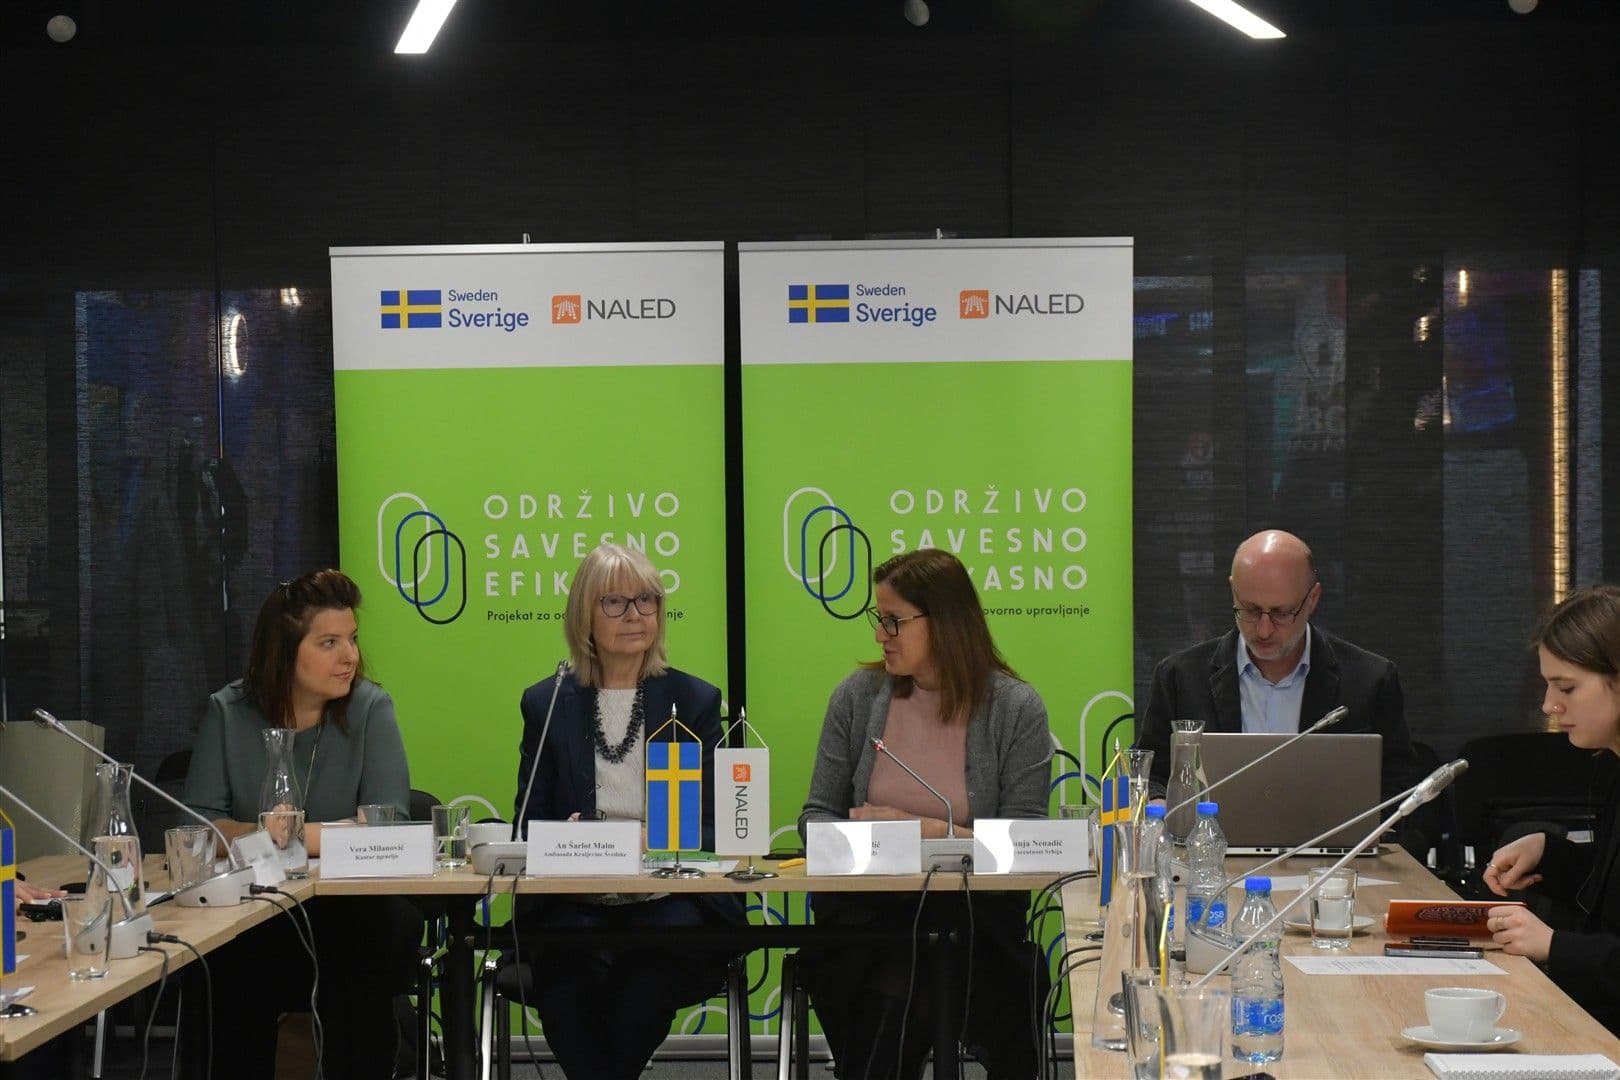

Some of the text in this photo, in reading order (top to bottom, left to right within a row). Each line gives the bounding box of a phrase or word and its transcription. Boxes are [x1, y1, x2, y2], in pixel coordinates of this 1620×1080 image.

[447, 288, 498, 302] Sweden
[855, 283, 906, 297] Sweden
[586, 298, 677, 320] NALED
[855, 302, 937, 327] Sverige
[994, 293, 1085, 315] NALED
[447, 307, 530, 332] Sverige
[483, 488, 680, 520] ODRŽIVO
[889, 484, 1088, 515] ODRŽIVO
[890, 527, 1087, 554] SAVESNO
[485, 569, 681, 597] EFIKO
[487, 610, 533, 625] Projekat
[536, 611, 550, 621] za
[1026, 604, 1090, 619] upravljanje
[735, 785, 748, 839] NALED
[369, 844, 404, 853] Milanović
